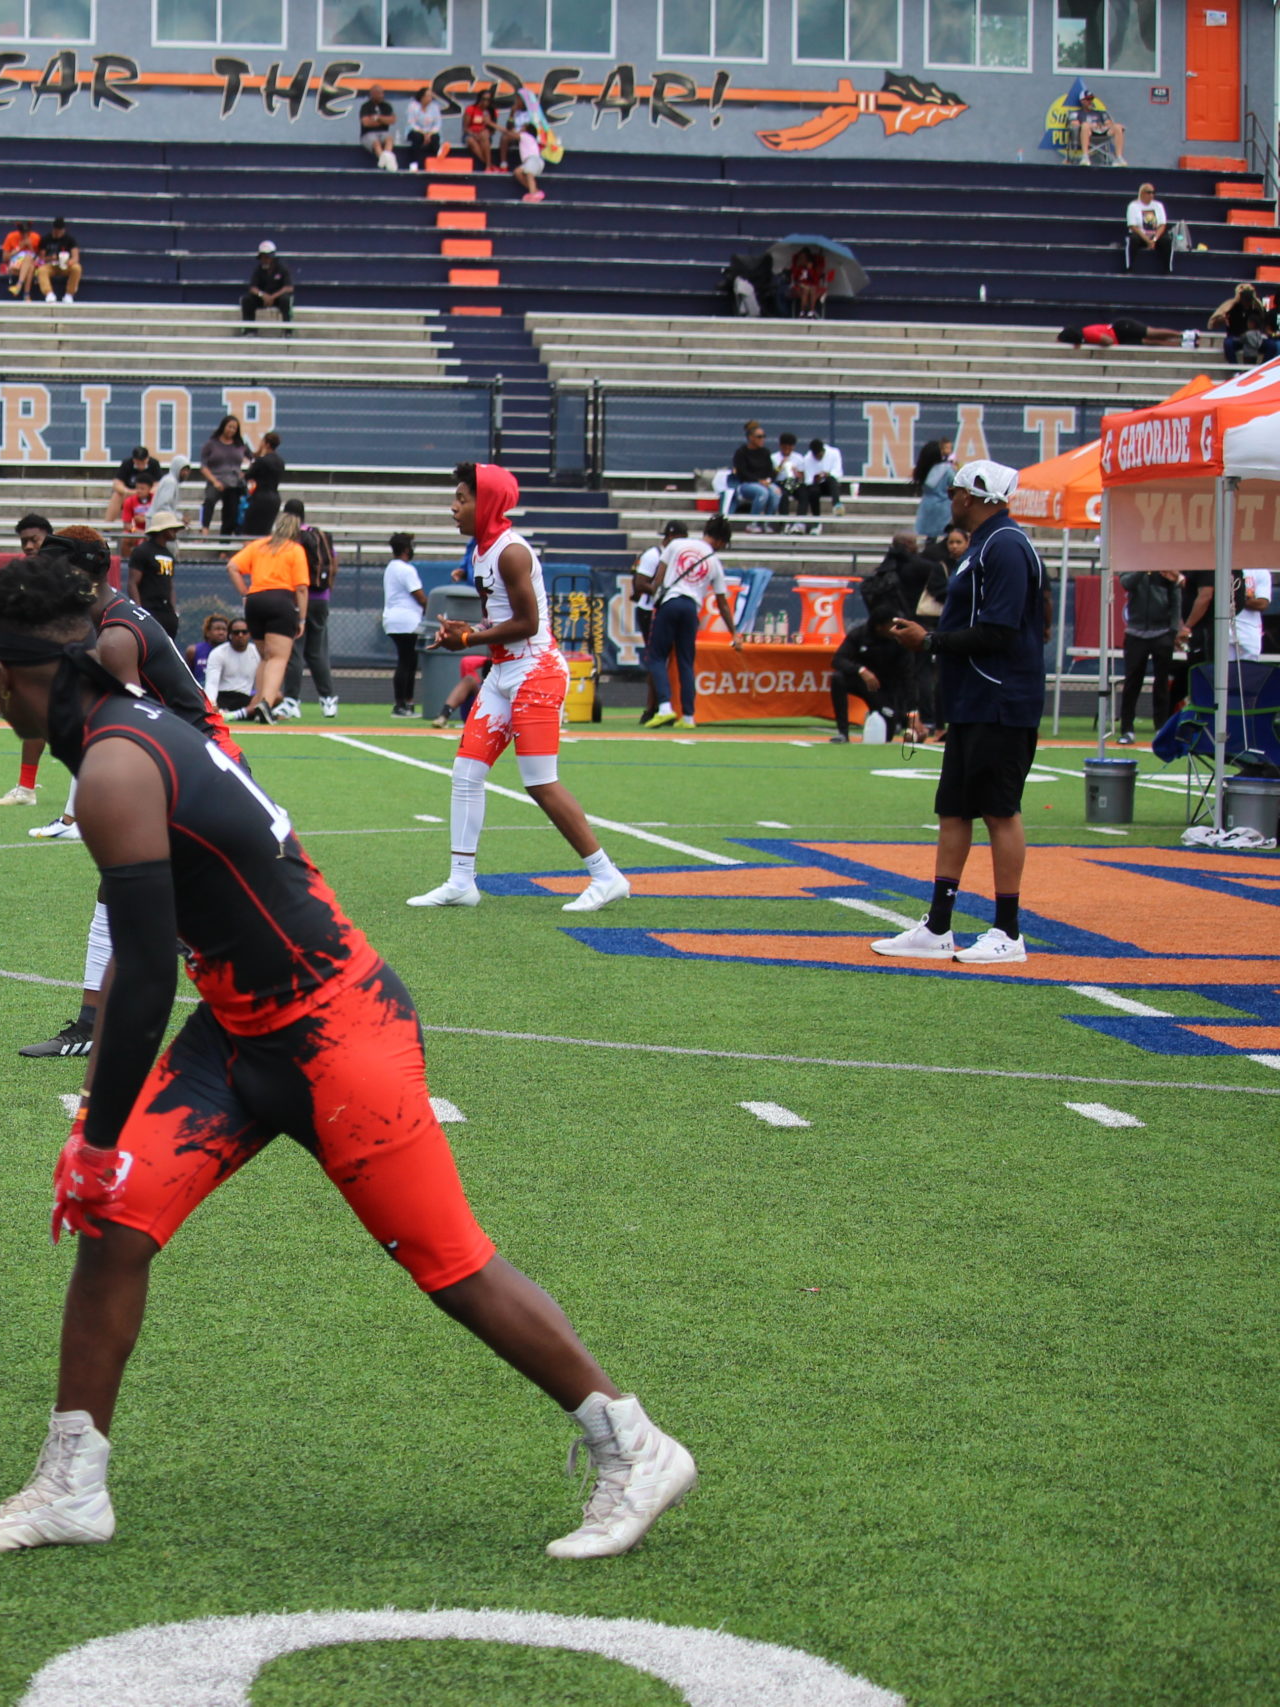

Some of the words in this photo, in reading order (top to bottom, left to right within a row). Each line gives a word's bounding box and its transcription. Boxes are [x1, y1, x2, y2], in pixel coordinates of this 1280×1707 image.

[212, 57, 363, 123] THE
[863, 402, 1133, 480] NAT
[1118, 416, 1191, 471] GATORADE
